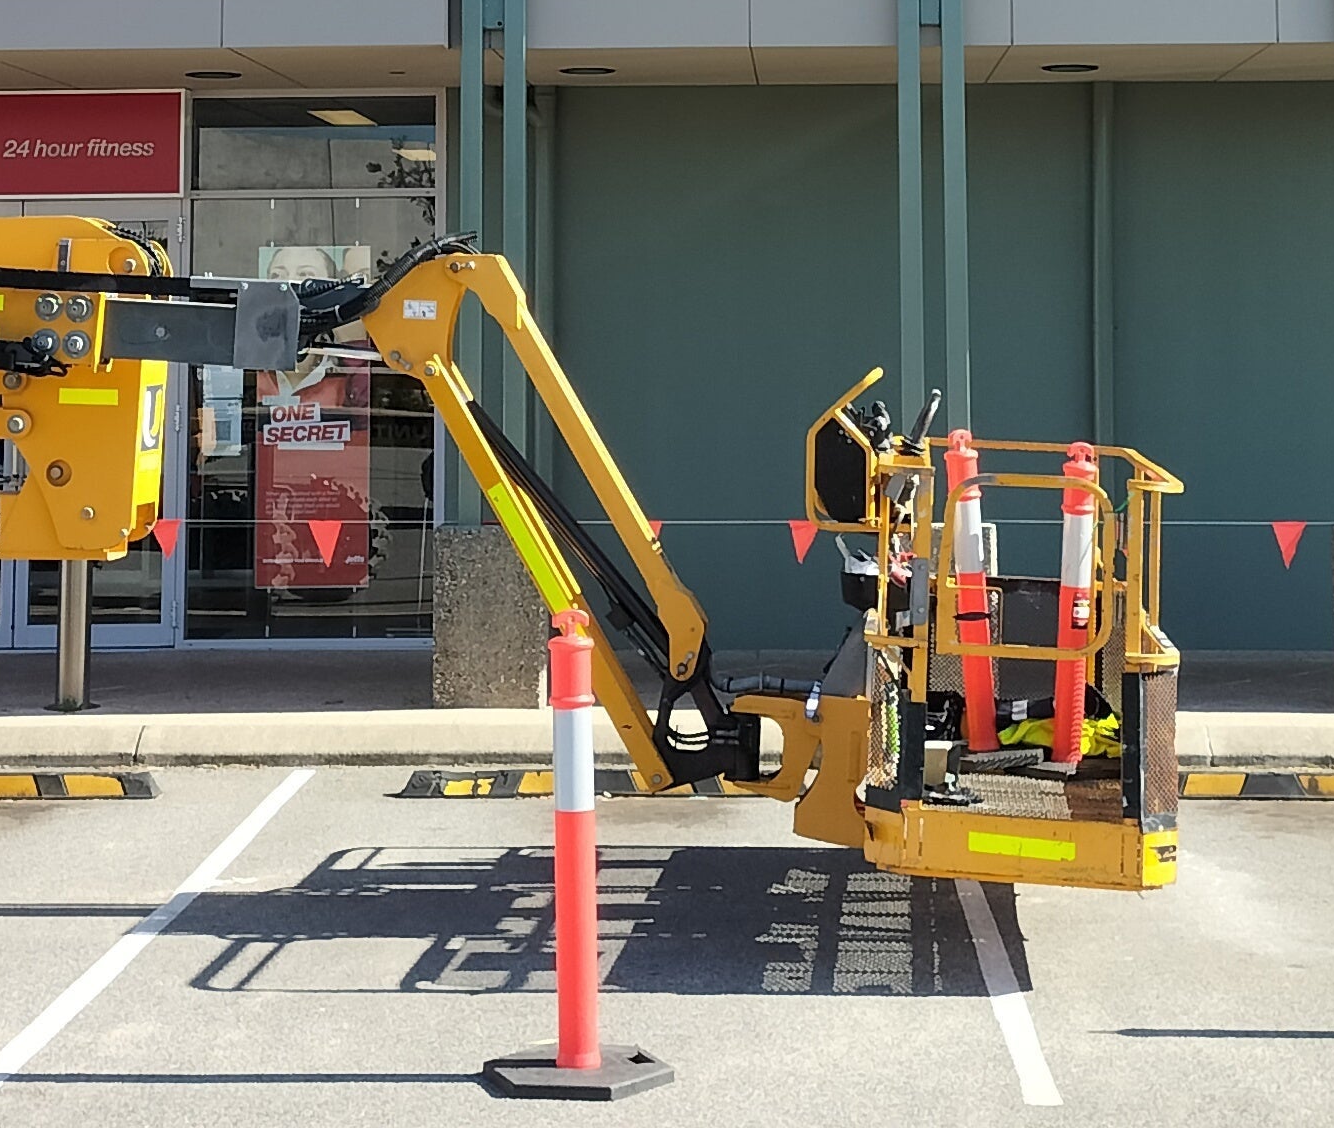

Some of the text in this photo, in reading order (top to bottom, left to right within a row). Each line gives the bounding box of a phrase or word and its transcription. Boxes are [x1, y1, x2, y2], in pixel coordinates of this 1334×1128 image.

[3, 140, 29, 158] 24
[33, 139, 83, 158] hour
[87, 138, 155, 157] fitness
[272, 403, 316, 423] ONE
[265, 423, 348, 443] SECRET
